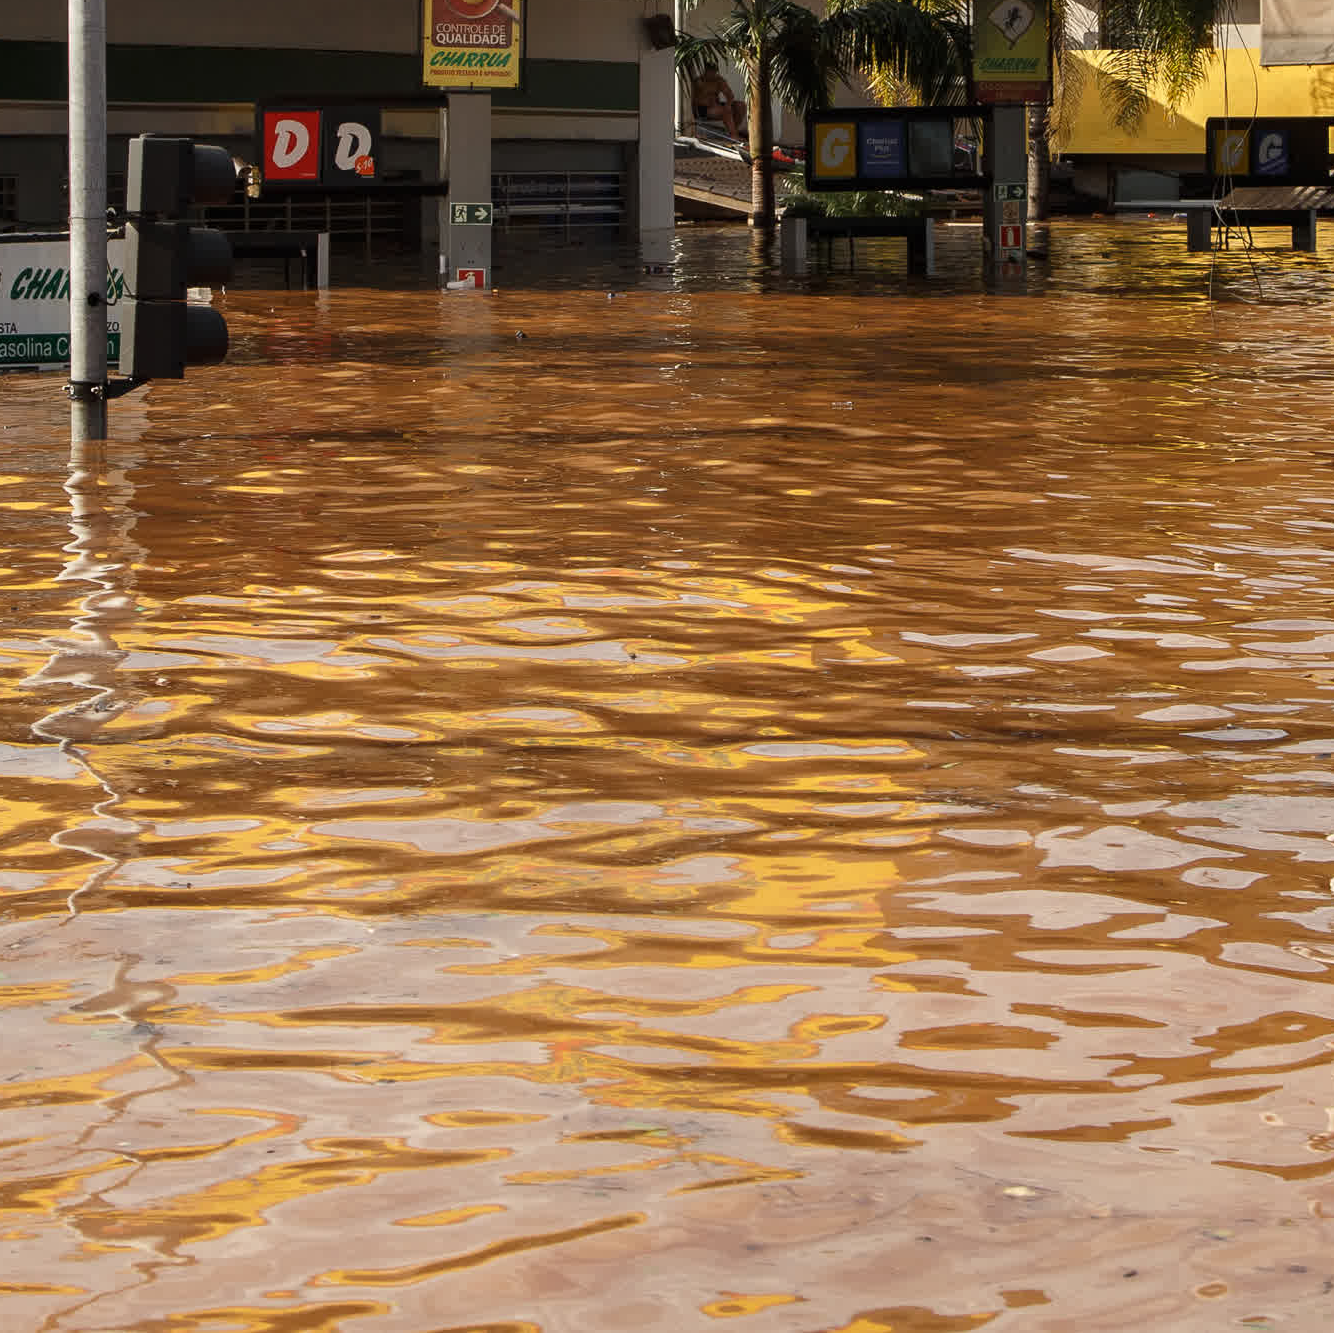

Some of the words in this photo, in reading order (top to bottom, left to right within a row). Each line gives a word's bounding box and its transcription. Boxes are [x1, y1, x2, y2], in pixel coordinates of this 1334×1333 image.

[436, 23, 491, 34] CONTROLE
[492, 24, 506, 35] DE
[436, 34, 506, 45] QUALIDADE
[430, 51, 511, 67] CHARRUA
[272, 119, 309, 168] D
[335, 122, 371, 170] D
[820, 127, 851, 168] G
